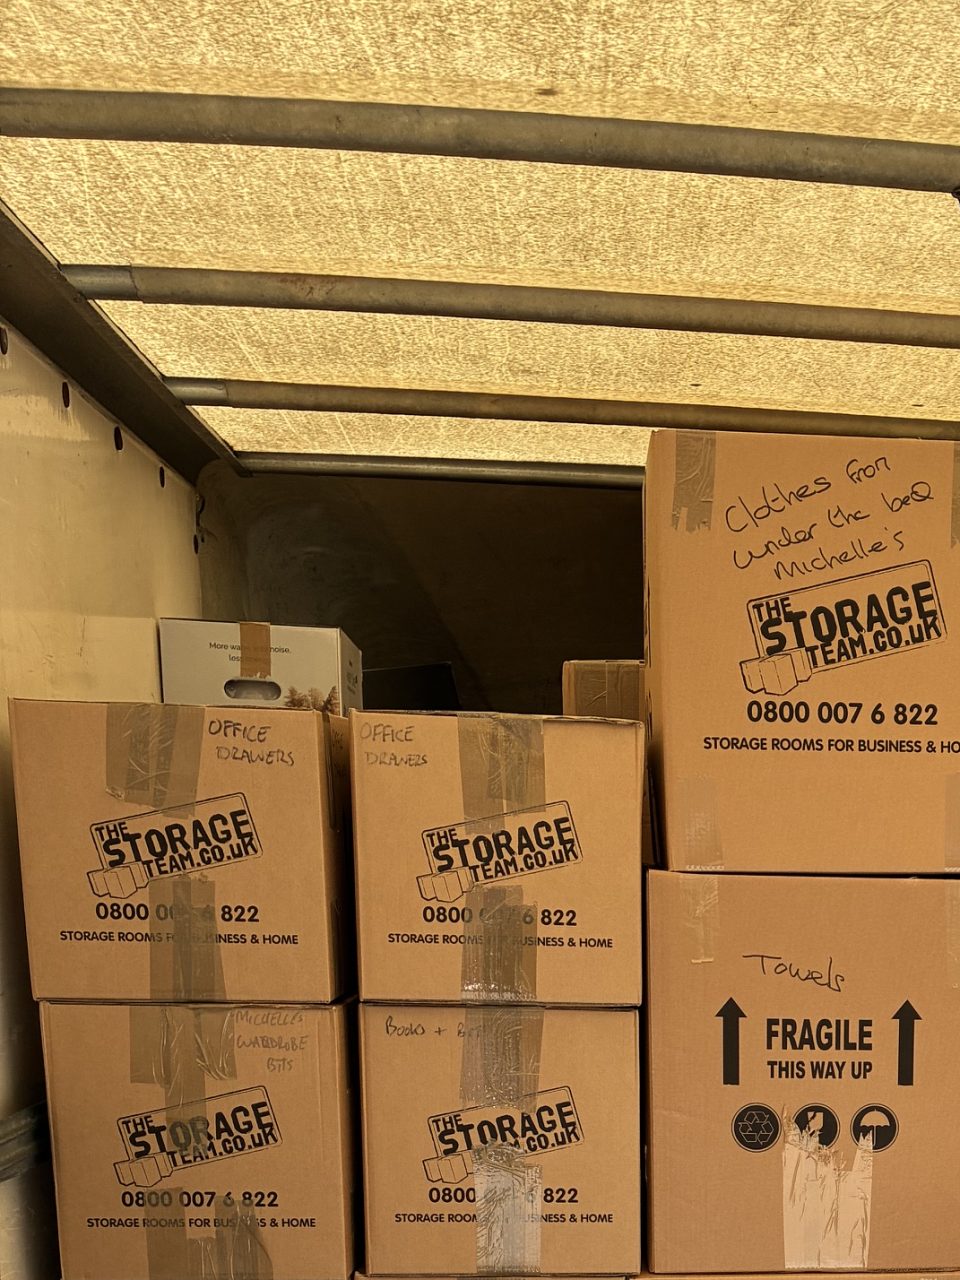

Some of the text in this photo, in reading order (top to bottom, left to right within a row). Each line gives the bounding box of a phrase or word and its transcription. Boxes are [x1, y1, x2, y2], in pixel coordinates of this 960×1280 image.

[726, 476, 831, 532] Clothes
[734, 523, 818, 568] under
[828, 506, 871, 529] the
[752, 597, 793, 622] THE
[760, 581, 937, 656] STORAGE
[806, 615, 942, 668] TEAM.CO.UK
[208, 719, 271, 743] OFFICE
[747, 700, 938, 725] 0800 007 6 822
[360, 723, 414, 743] OFFICE
[703, 737, 768, 750] STORAGE
[771, 738, 823, 751] ROOMS
[828, 739, 854, 752] FOR
[858, 740, 922, 753] BUSINESS
[926, 741, 936, 753] &
[96, 822, 128, 842] THE
[102, 810, 252, 868] STORAGE
[426, 829, 458, 848] THE
[433, 816, 575, 872] STORAGE
[144, 838, 258, 878] TEAM.CO.UK
[470, 843, 579, 882] TEAM.CO.UK
[742, 954, 845, 992] Towels
[766, 1018, 873, 1051] FRAGILE
[767, 1061, 873, 1079] THIS WAY UP
[122, 1116, 154, 1135] THE
[129, 1102, 272, 1158] STORAGE
[168, 1127, 278, 1167] TEAM.CO.UK
